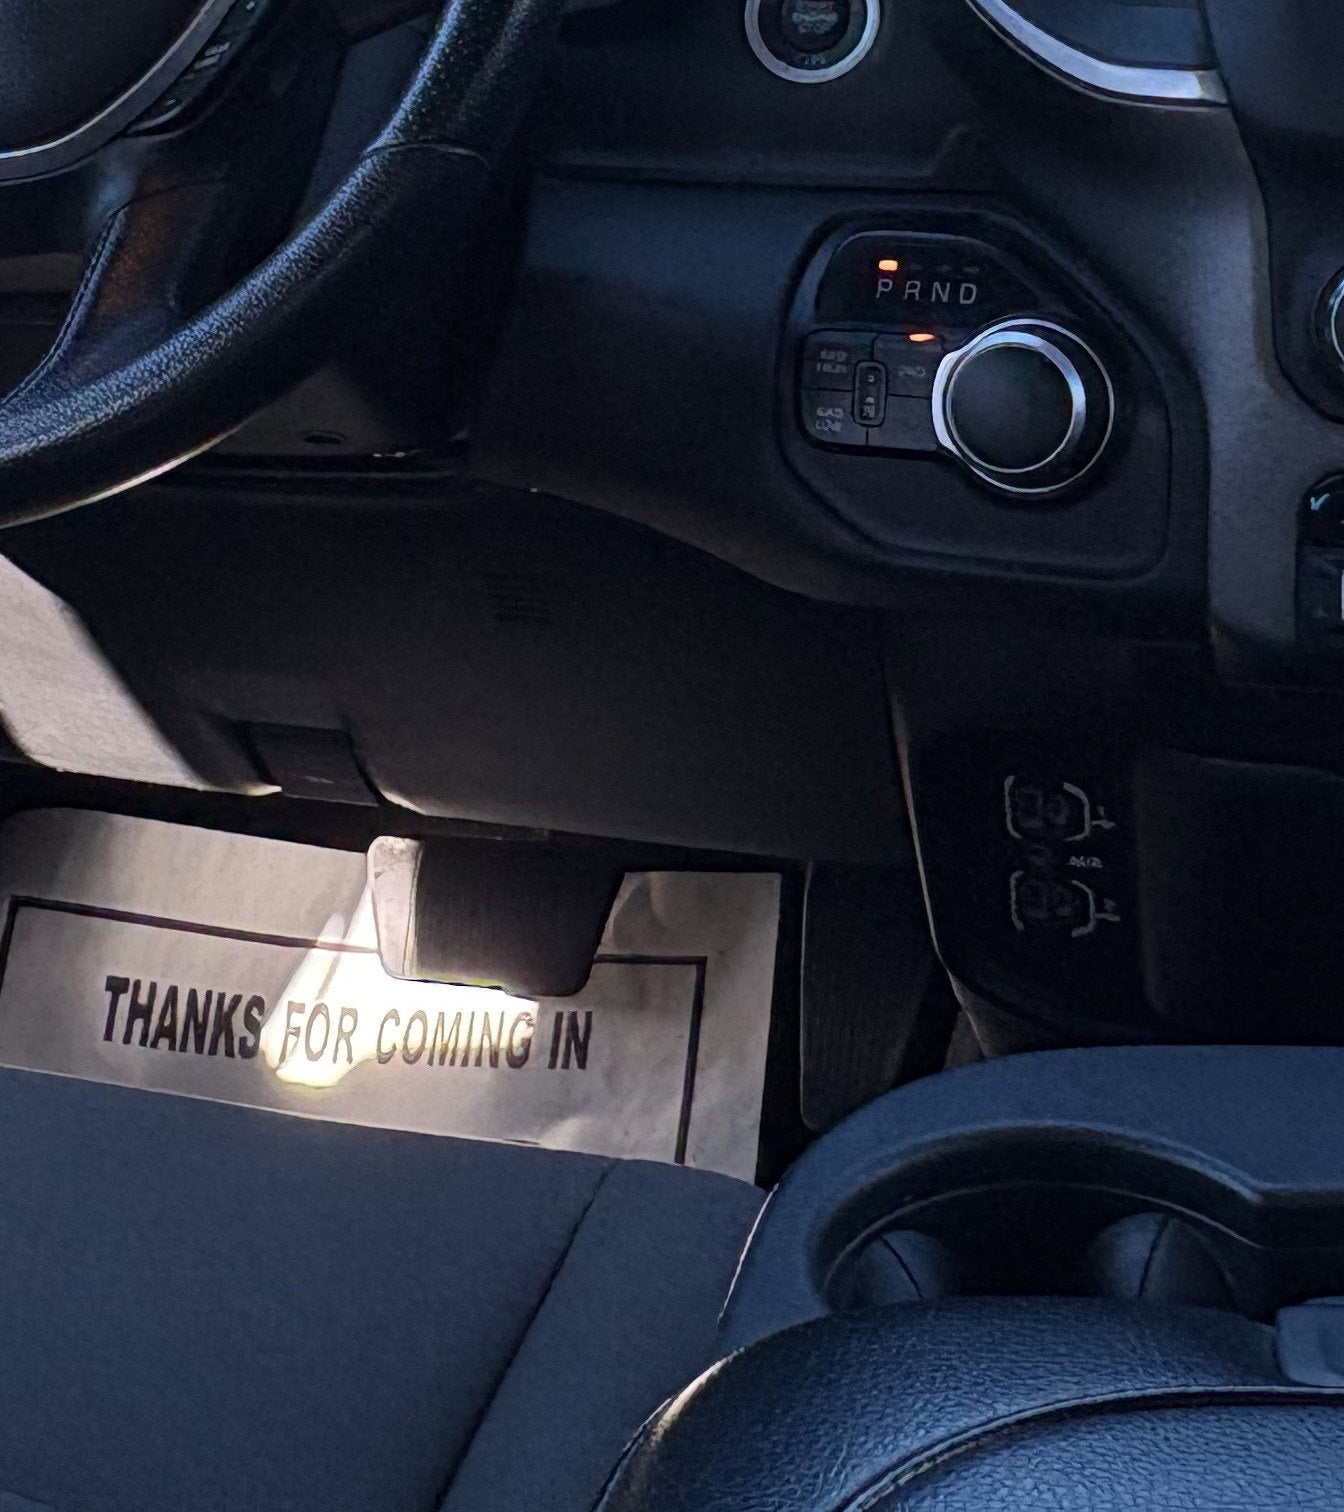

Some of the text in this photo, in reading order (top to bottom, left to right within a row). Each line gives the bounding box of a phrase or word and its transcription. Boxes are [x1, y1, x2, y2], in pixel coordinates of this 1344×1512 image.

[875, 278, 977, 305] P R N D
[104, 976, 594, 1071] THANKS FOR COMING IN
